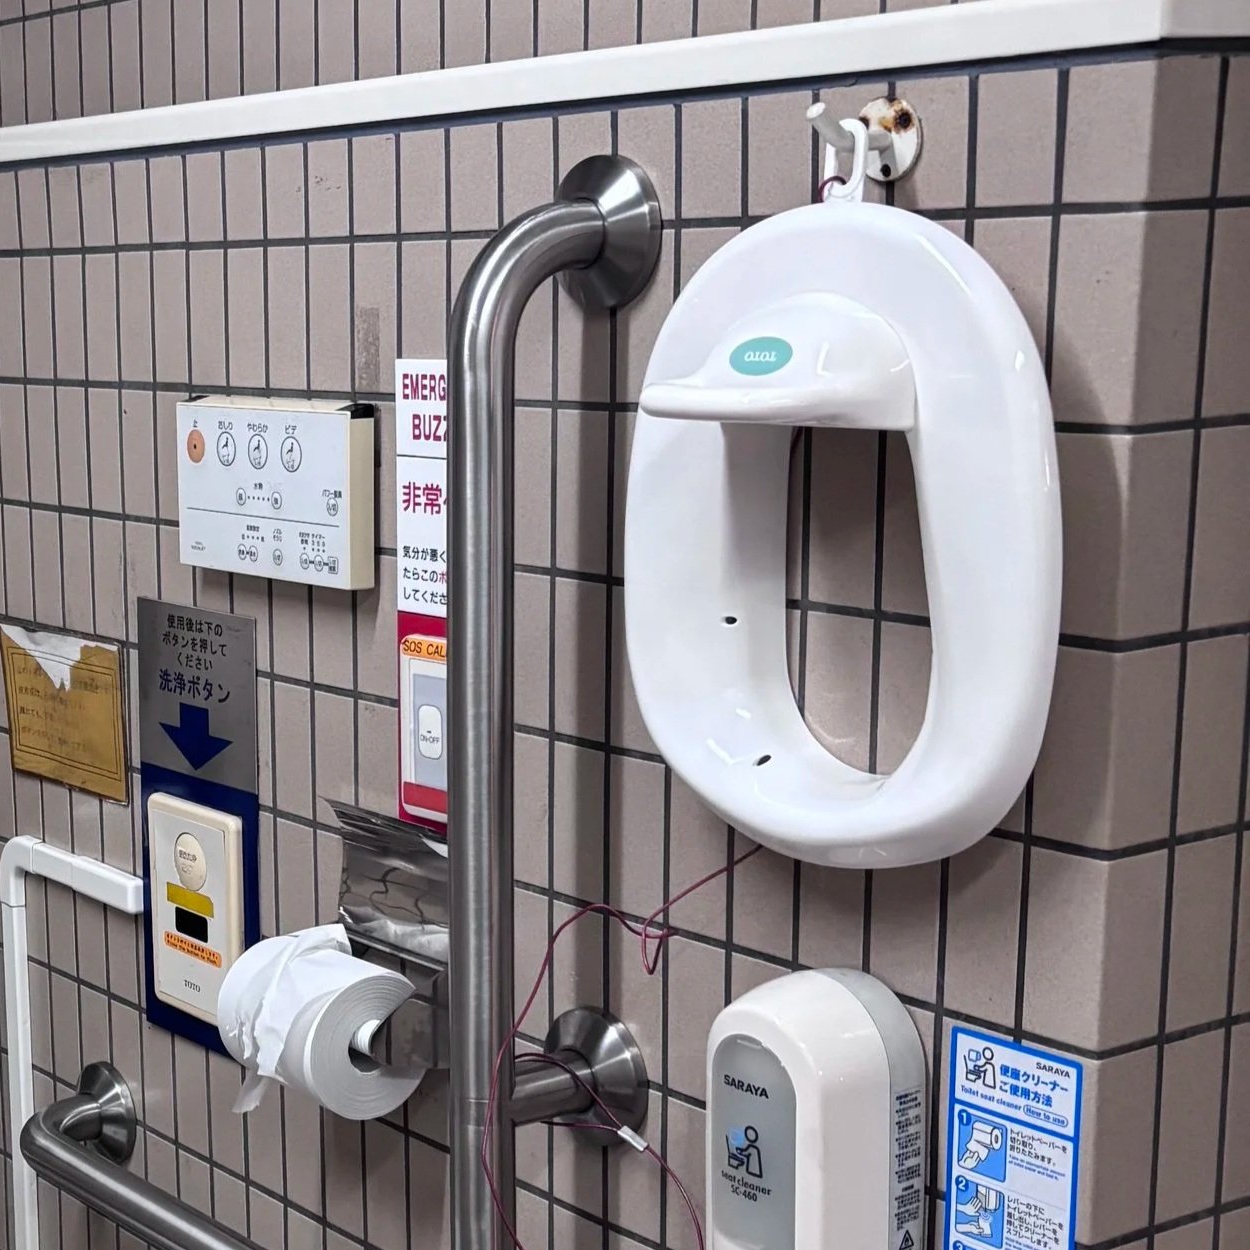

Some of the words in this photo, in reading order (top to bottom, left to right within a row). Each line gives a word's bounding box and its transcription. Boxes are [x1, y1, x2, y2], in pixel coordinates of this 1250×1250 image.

[218, 421, 233, 431] おしり
[247, 422, 268, 433] やわらか
[285, 424, 297, 434] ビデ
[402, 481, 447, 515] 非常
[167, 613, 223, 637] 使用後は下の
[162, 632, 227, 657] ボタンを押して
[403, 640, 422, 654] SOS
[176, 652, 213, 671] ください
[159, 668, 230, 703] 洗浄ボタン
[184, 980, 200, 993] TOTO
[1000, 1064, 1068, 1092] 便座クリーナー
[1036, 1062, 1070, 1079] SARAYA
[724, 1074, 769, 1099] SARAYA
[1000, 1080, 1053, 1108] ご使用方法
[961, 1085, 979, 1097] Toilet
[980, 1093, 995, 1102] seat
[996, 1098, 1022, 1111] cleaner
[1026, 1106, 1041, 1117] How
[1052, 1117, 1065, 1125] use
[960, 1112, 968, 1126] 1
[1010, 1128, 1067, 1154] トイレットペーパーを
[731, 1184, 757, 1202] SC-460
[737, 1176, 772, 1195] cleaner
[958, 1178, 966, 1190] 2
[1008, 1195, 1044, 1215] レバーの下に
[1007, 1203, 1064, 1231] トイレットペーパーを
